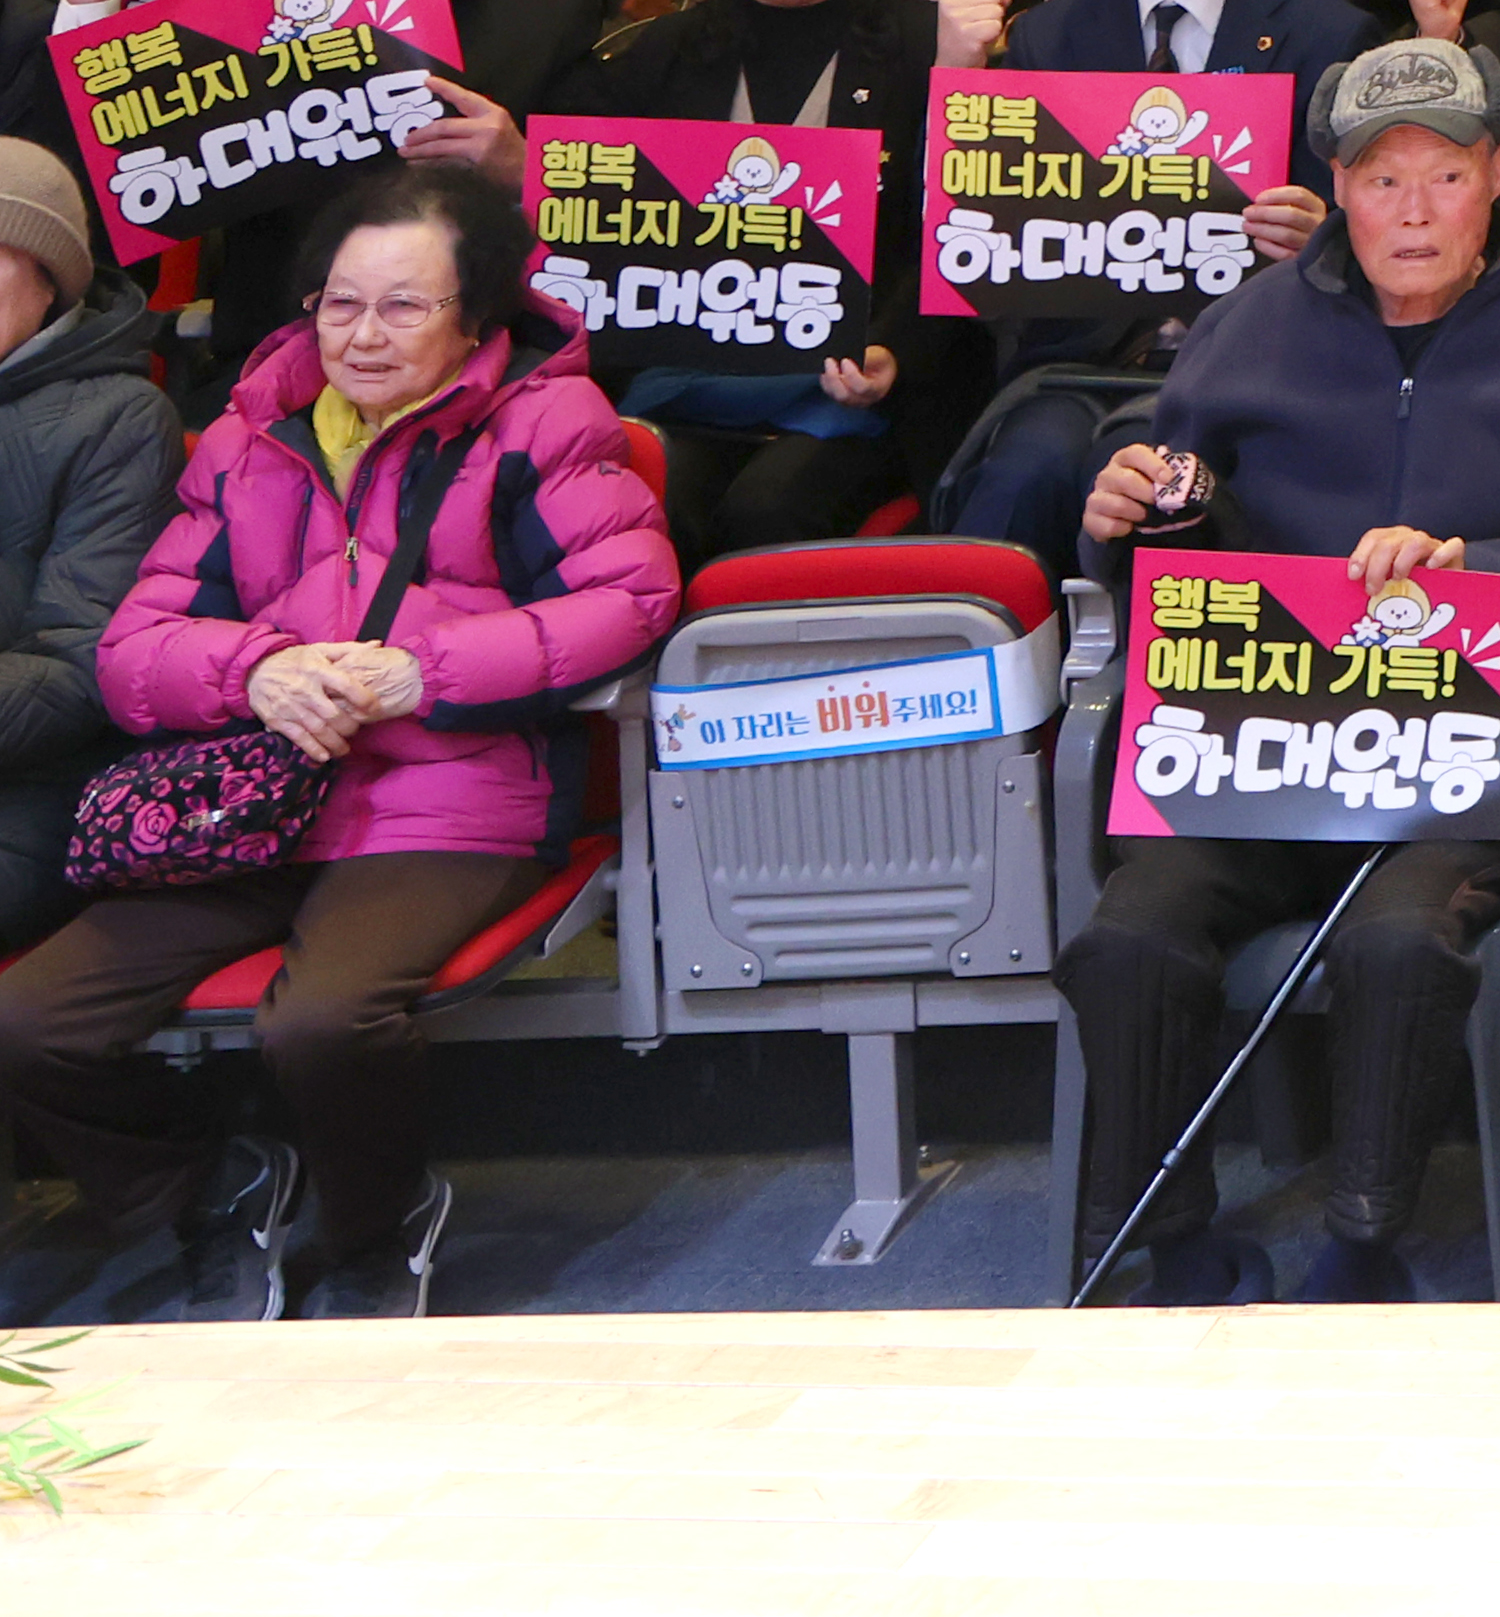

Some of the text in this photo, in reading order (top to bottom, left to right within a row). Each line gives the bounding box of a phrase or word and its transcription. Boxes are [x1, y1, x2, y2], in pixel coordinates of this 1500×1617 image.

[73, 21, 182, 97] 행복
[89, 24, 379, 148] 에너지 가득!
[108, 69, 444, 226] 하대원동
[943, 91, 1037, 145] 행복
[540, 139, 637, 193] 행복
[941, 150, 1210, 203] 에너지 가득!
[537, 196, 804, 253] 에너지 가득!
[936, 209, 1256, 296] 하대원동
[1149, 574, 1263, 633] 행복
[1144, 636, 1458, 700] 에너지 가득!
[700, 720, 727, 745] 이
[733, 709, 811, 743] 자리는
